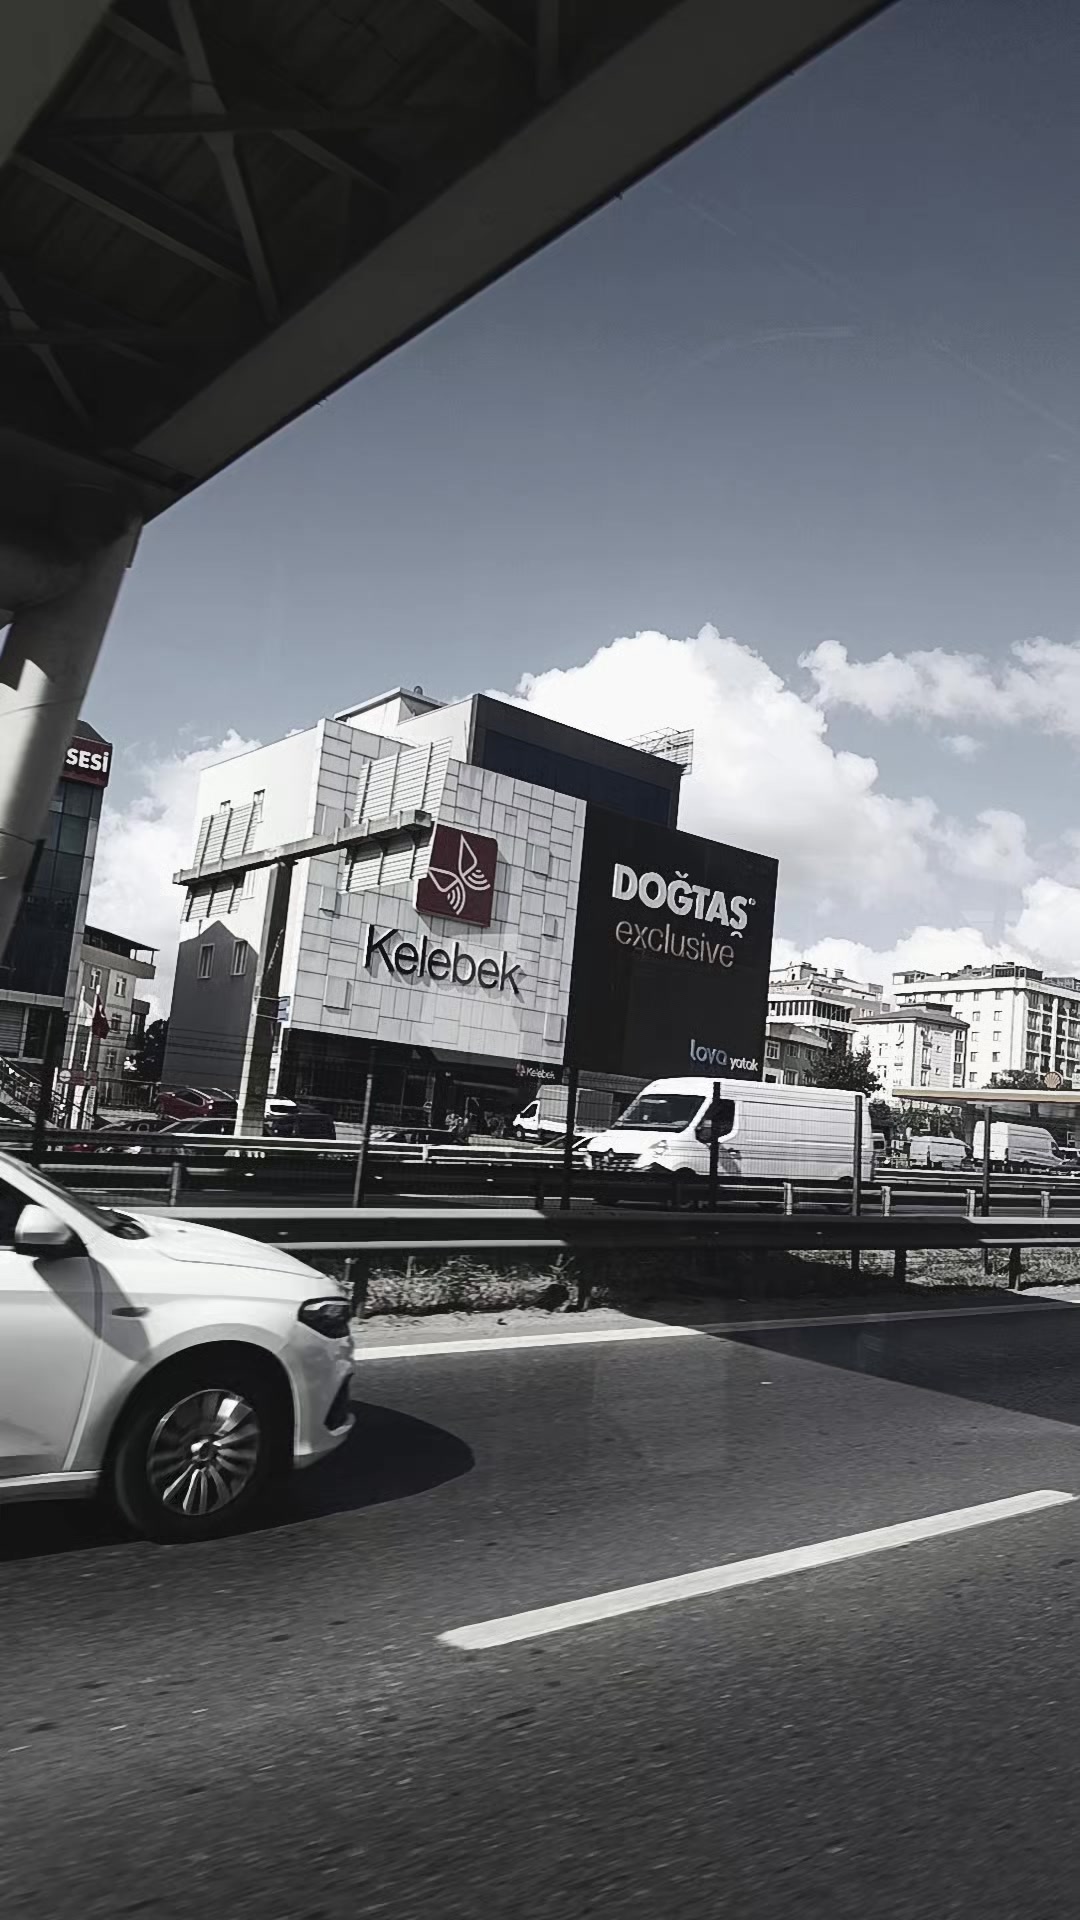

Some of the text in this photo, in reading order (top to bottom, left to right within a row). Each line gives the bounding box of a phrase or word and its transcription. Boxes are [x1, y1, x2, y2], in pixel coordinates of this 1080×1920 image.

[362, 923, 521, 995] Kelebek
[615, 920, 735, 968] exclusive
[690, 1038, 759, 1072] lova yatak
